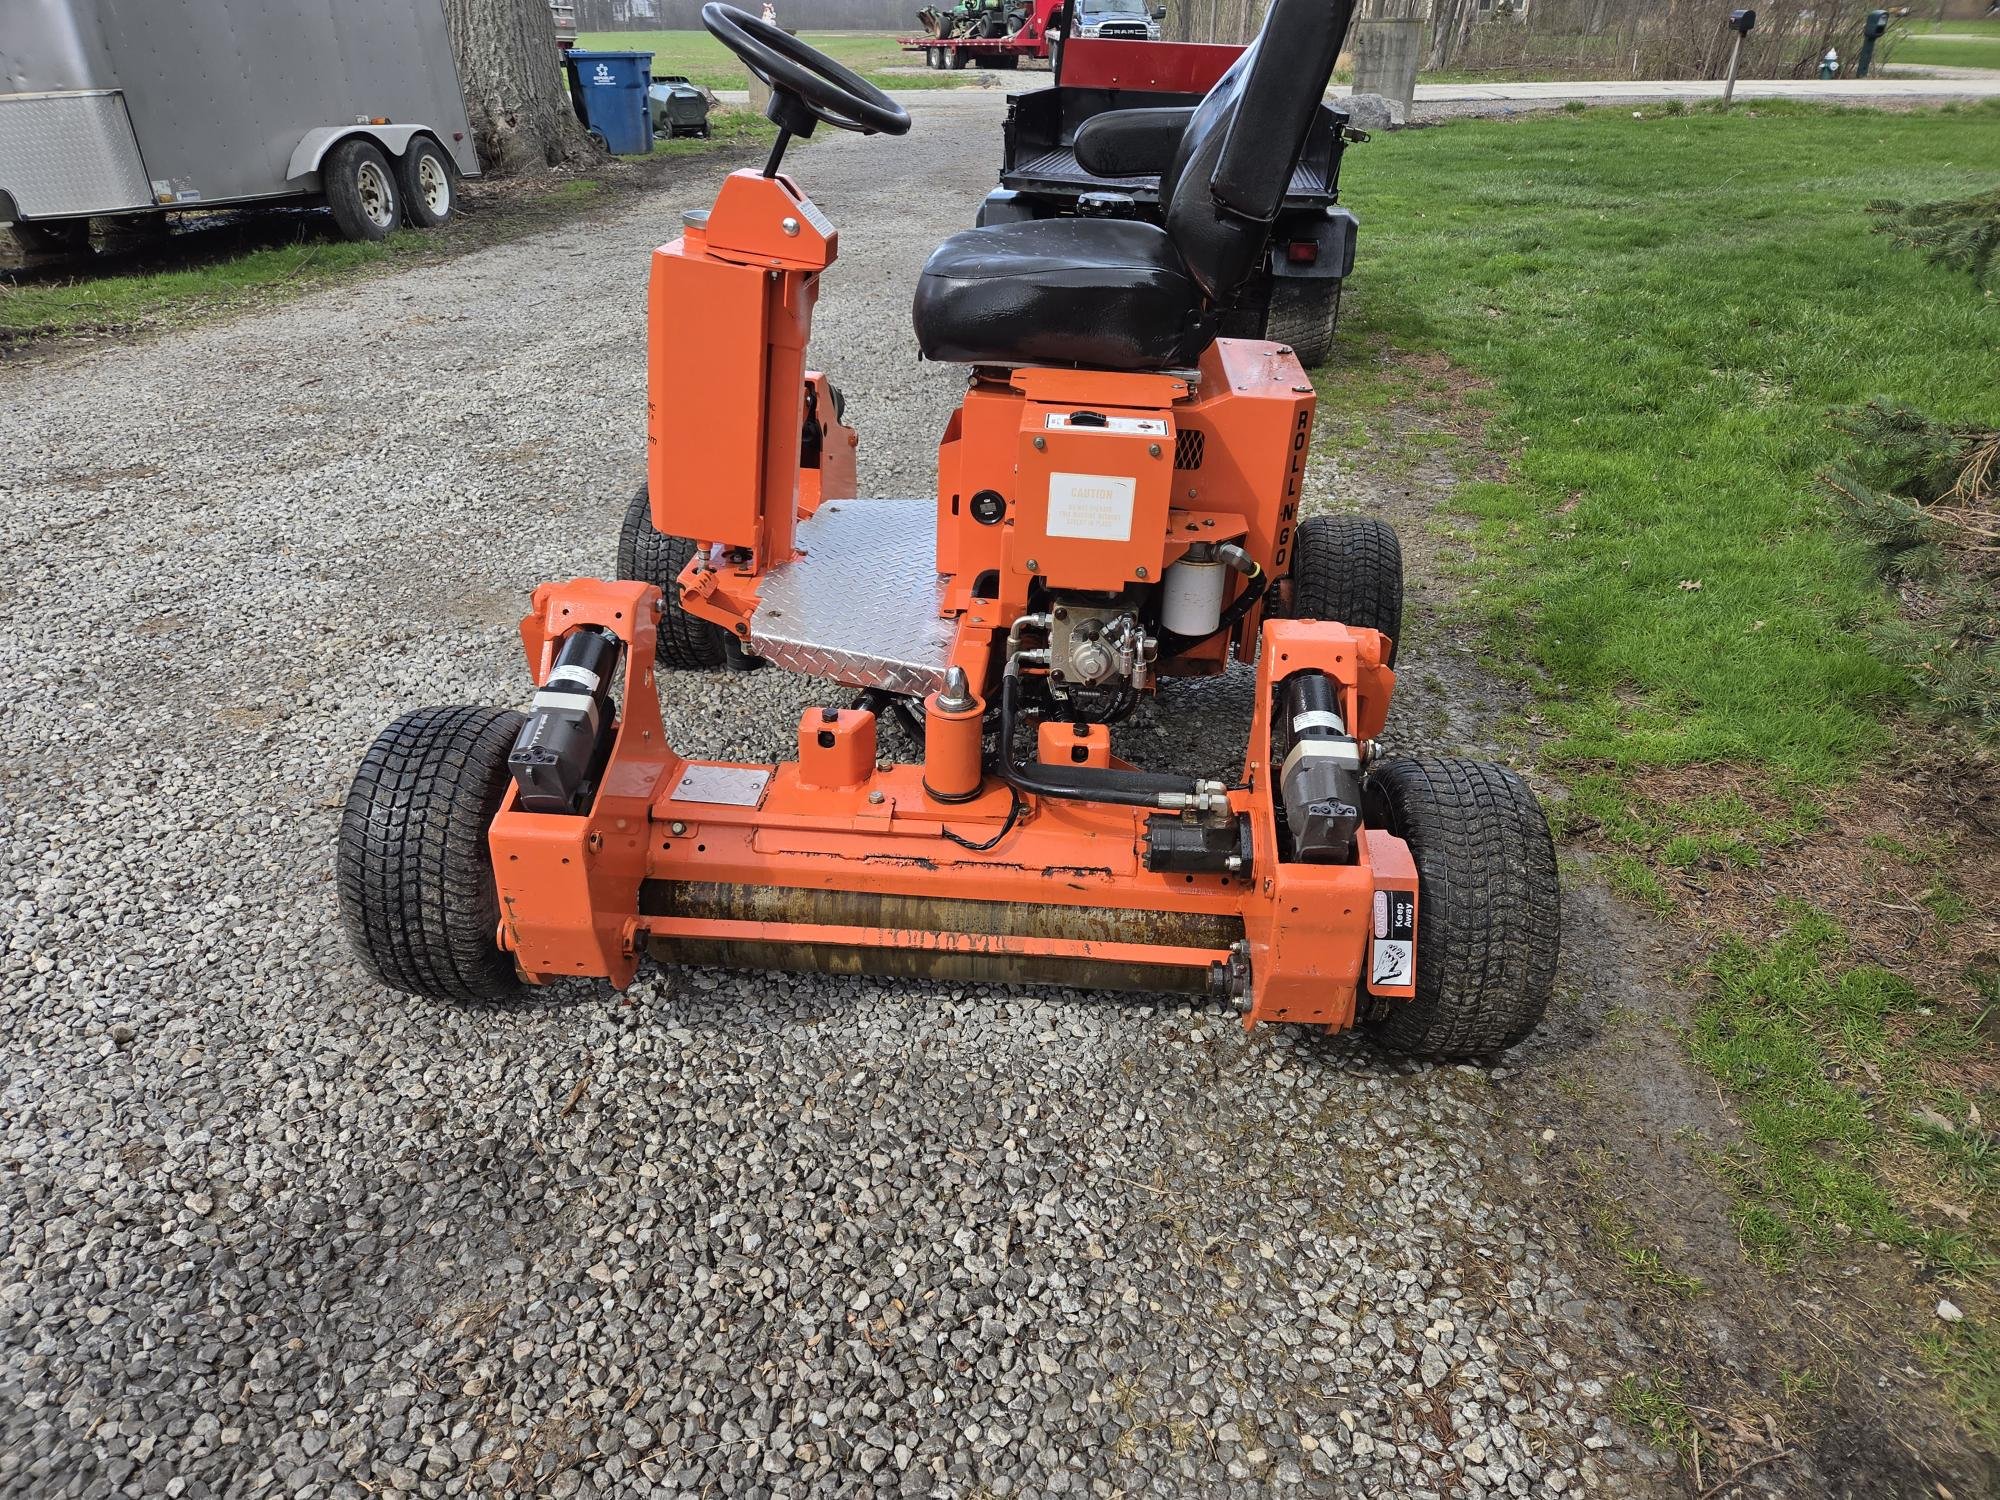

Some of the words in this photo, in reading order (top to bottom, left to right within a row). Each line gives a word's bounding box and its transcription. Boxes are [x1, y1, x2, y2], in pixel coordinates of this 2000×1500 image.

[1287, 411, 1309, 497] ROLL
[1072, 487, 1113, 500] CAUTION
[1275, 528, 1290, 566] GO
[1375, 893, 1386, 936] DANGER
[1395, 902, 1405, 928] Keep
[1404, 903, 1414, 928] Away
